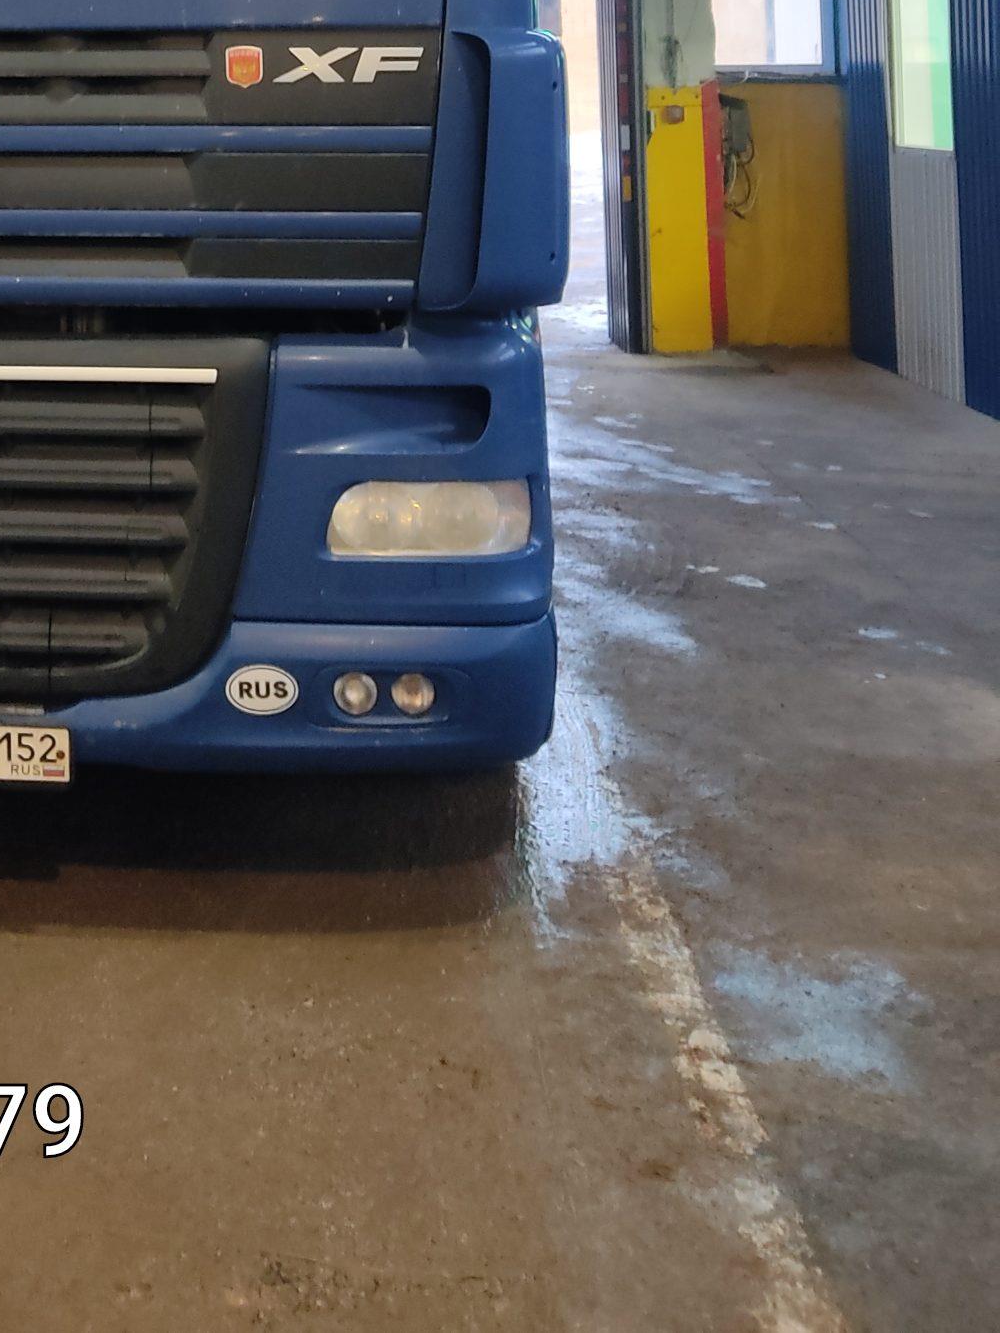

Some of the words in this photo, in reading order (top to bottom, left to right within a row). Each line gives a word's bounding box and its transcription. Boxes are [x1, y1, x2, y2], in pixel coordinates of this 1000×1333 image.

[272, 46, 425, 84] XF
[238, 680, 289, 699] RUS
[10, 763, 41, 776] RUS
